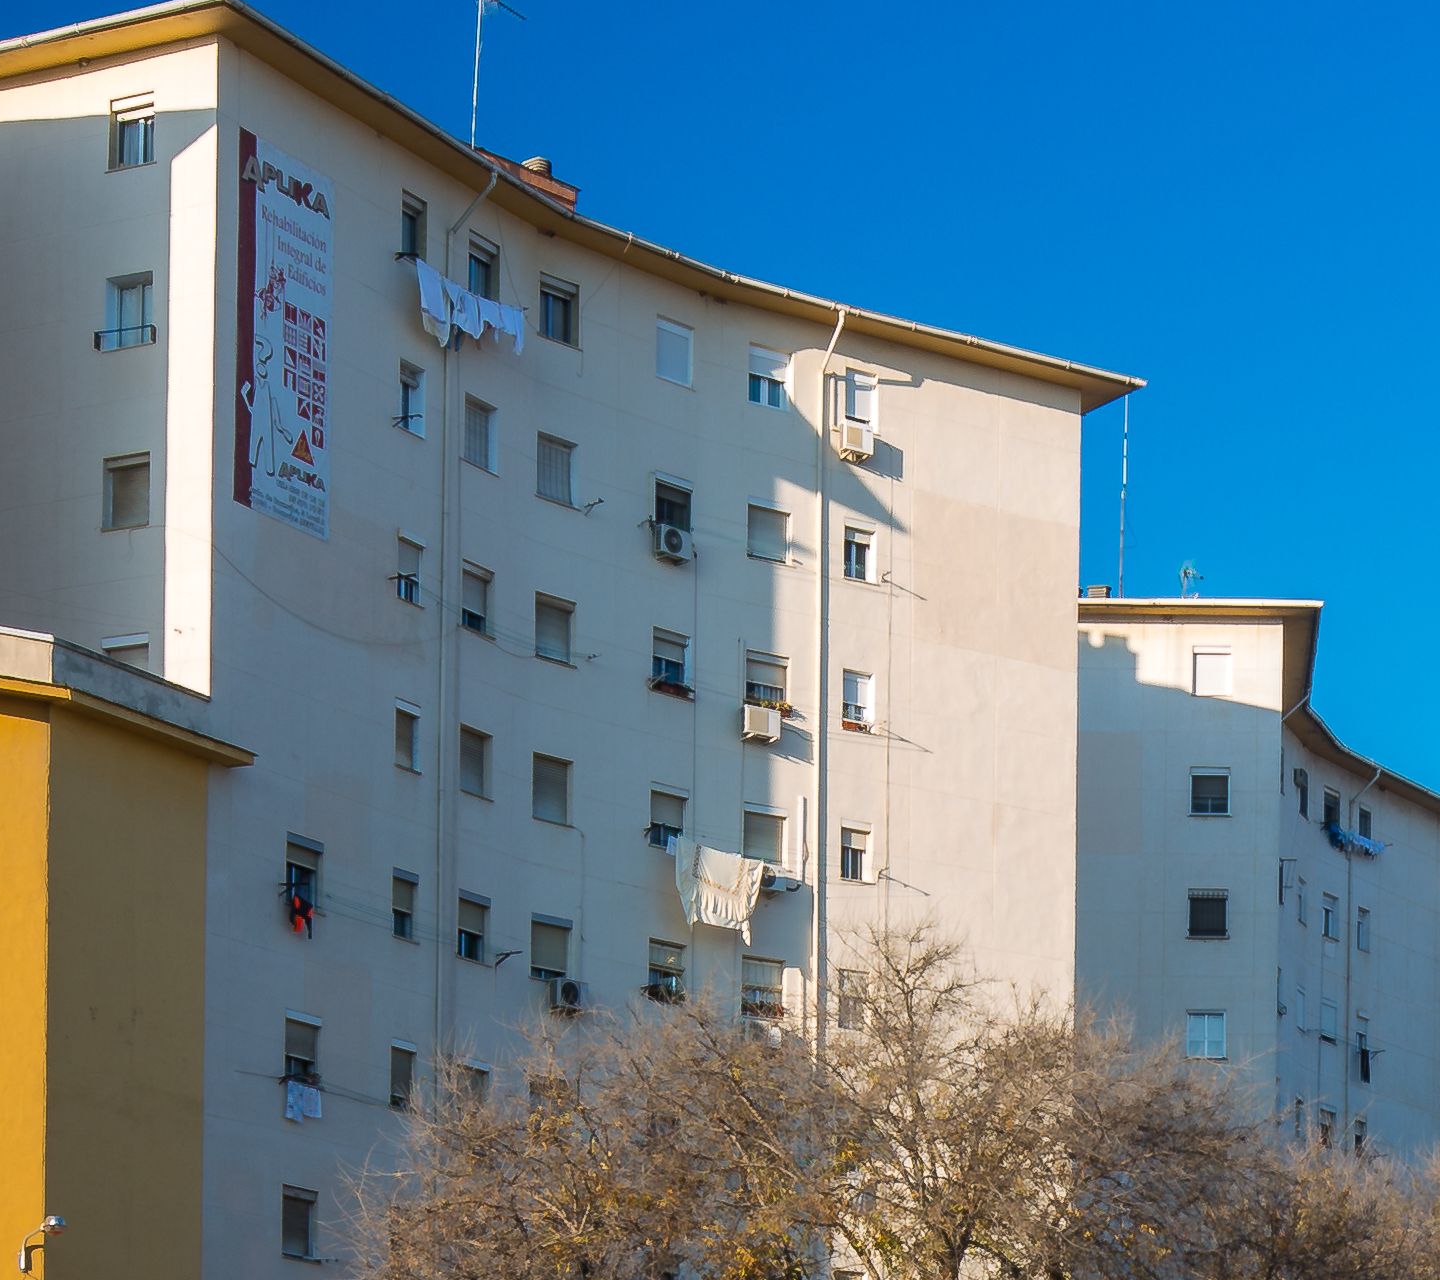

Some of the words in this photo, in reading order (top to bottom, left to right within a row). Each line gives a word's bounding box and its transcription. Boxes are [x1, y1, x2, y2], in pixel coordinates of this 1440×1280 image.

[241, 155, 330, 220] APLIKA
[261, 204, 327, 253] Rehabilitación
[277, 235, 313, 267] Integral
[314, 257, 326, 274] de
[287, 263, 327, 297] Edificios
[278, 462, 326, 492] APLIKA
